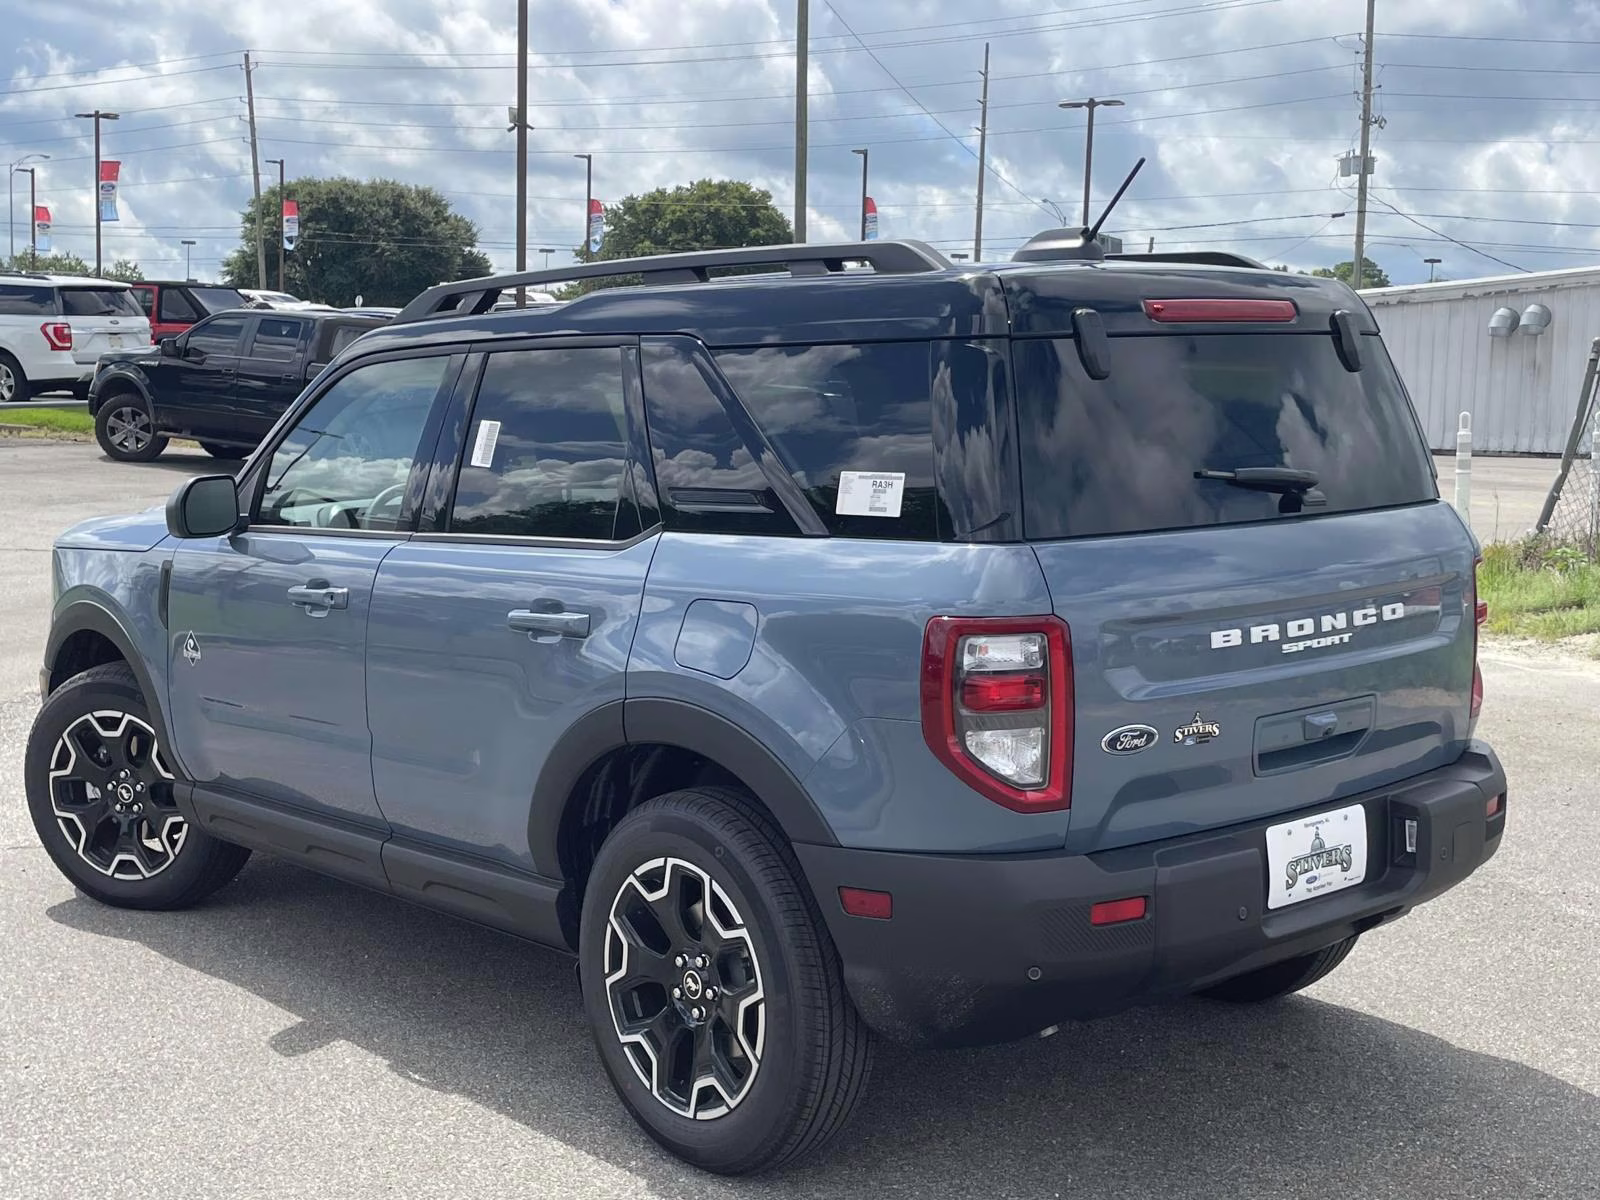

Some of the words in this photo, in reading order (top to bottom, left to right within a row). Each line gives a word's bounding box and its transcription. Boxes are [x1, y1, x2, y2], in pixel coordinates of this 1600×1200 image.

[872, 480, 894, 489] RA3H
[1210, 602, 1405, 649] BRONCO
[1281, 633, 1353, 653] SPORT
[1116, 731, 1148, 750] Ford
[1174, 723, 1220, 743] STIVERS
[1286, 844, 1352, 891] STIVERS
